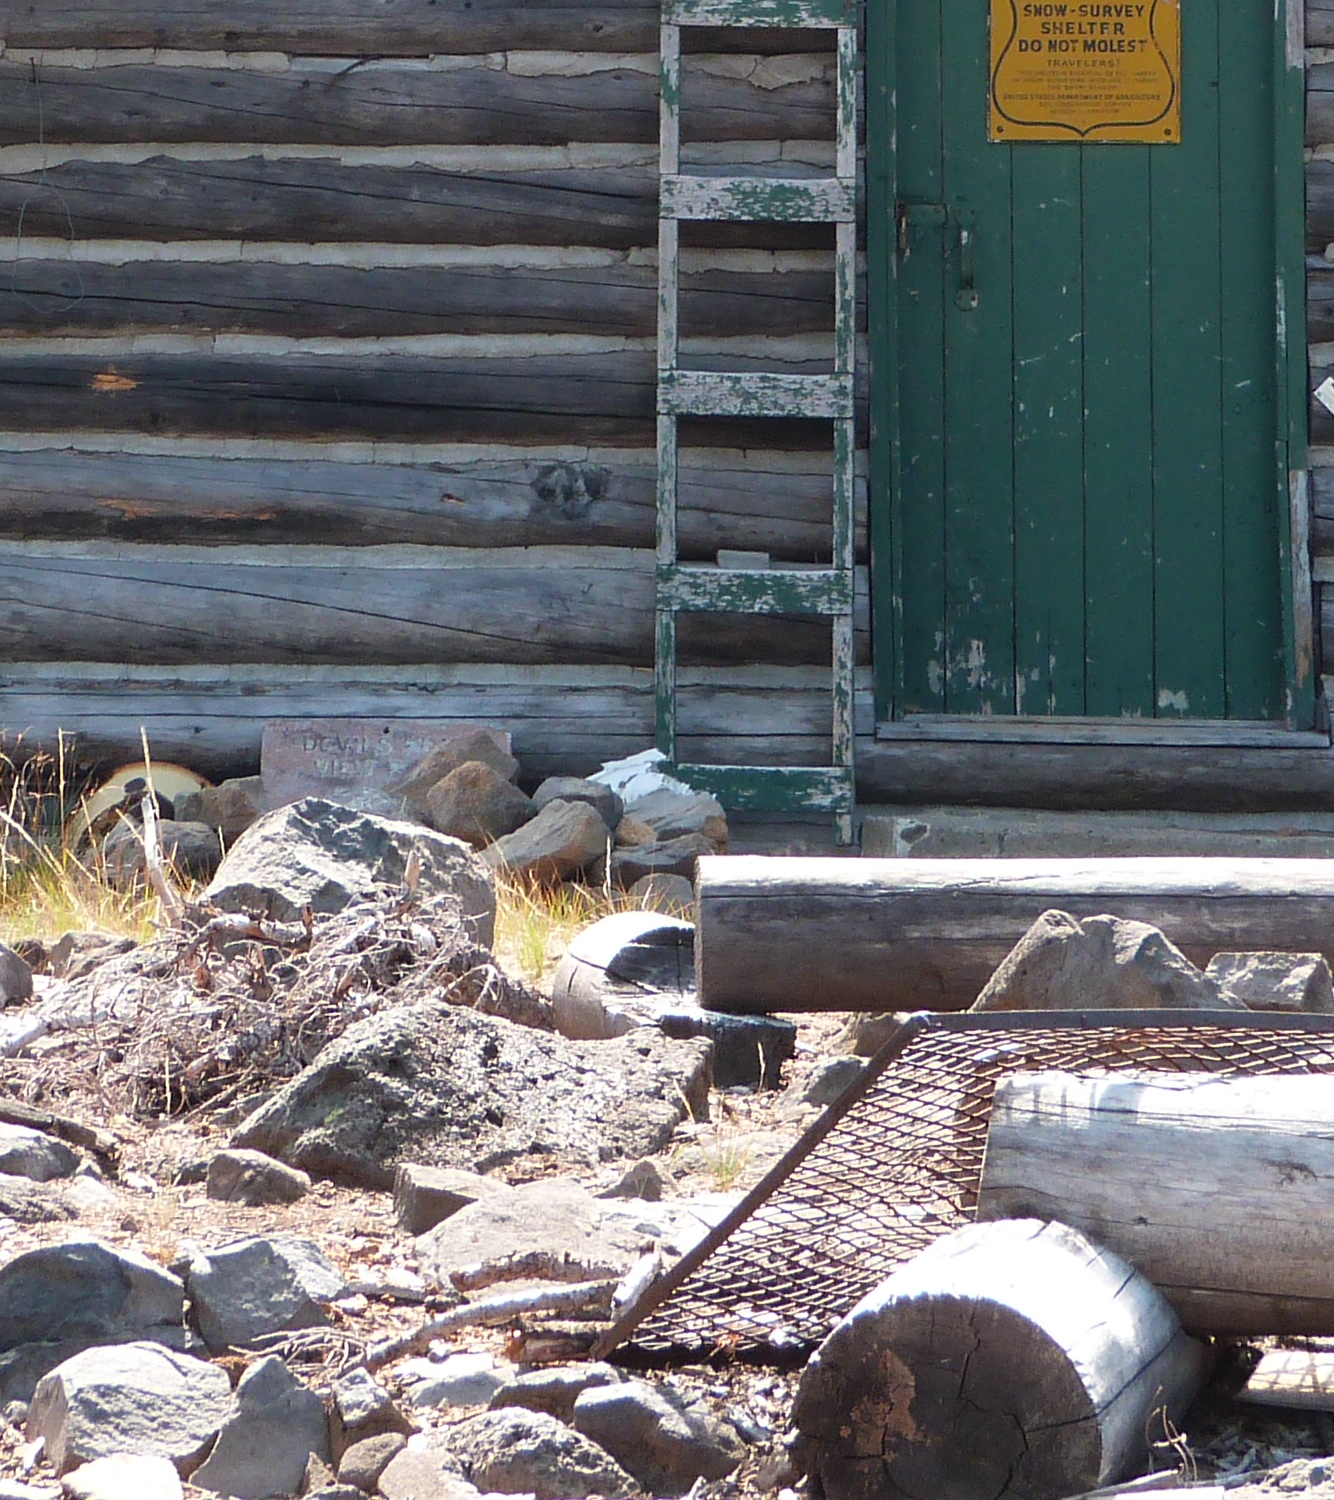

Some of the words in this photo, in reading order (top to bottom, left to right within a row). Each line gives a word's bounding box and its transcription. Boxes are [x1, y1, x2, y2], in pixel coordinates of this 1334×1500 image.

[1018, 39, 1043, 52] DO
[1048, 39, 1078, 52] NOT
[1083, 39, 1147, 53] MOLEST
